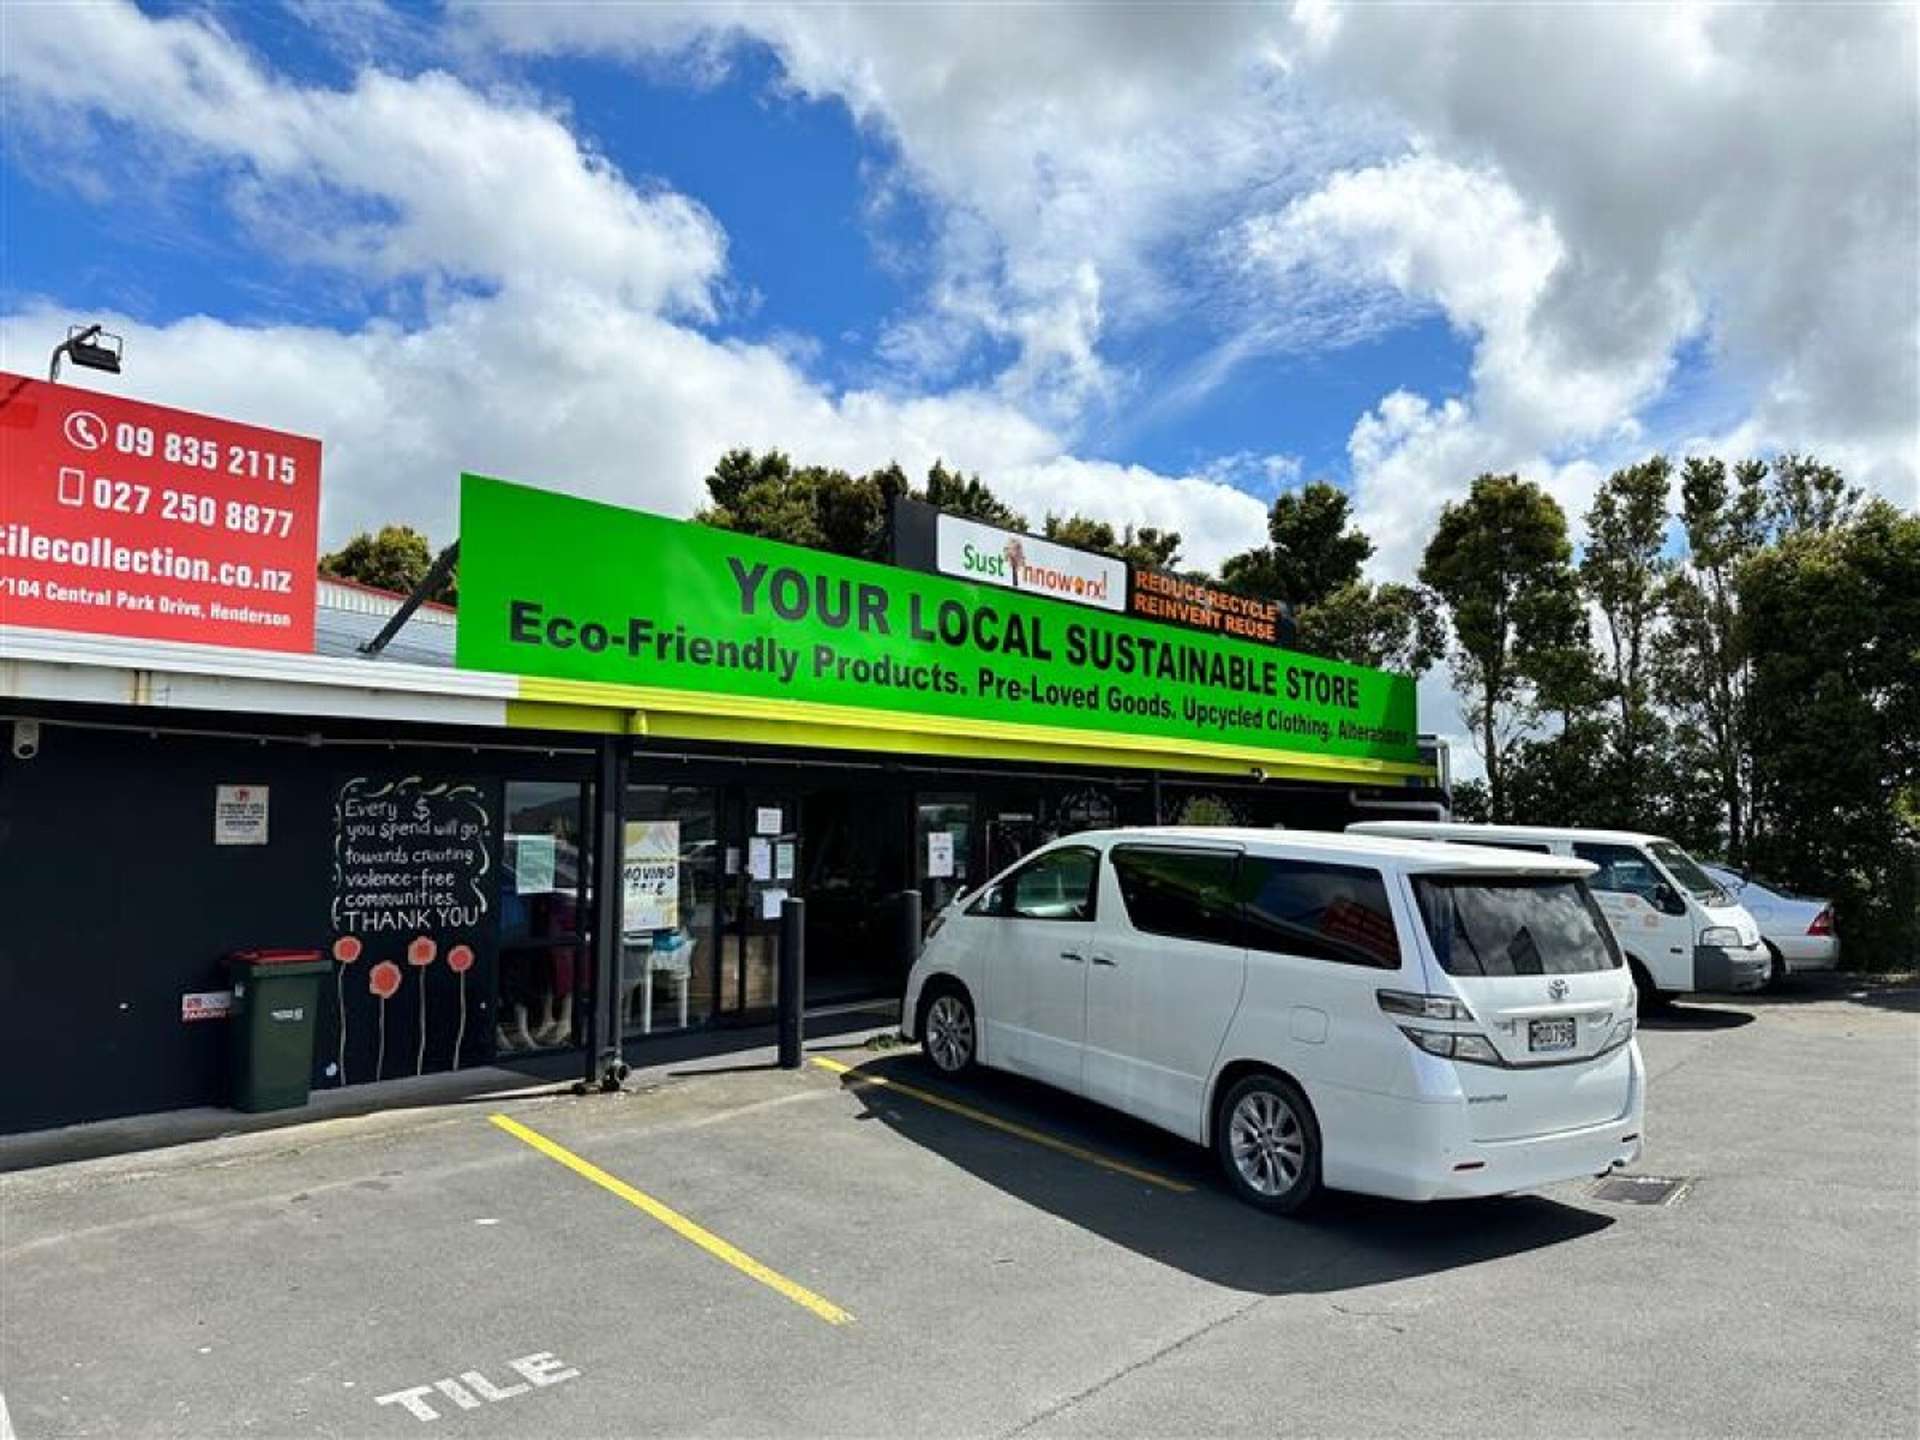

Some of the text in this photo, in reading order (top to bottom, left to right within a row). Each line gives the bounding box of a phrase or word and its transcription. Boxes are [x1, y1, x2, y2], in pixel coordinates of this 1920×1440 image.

[115, 421, 297, 485] 09 835 2115
[93, 478, 294, 539] 027 250 8877
[46, 581, 111, 607] Central
[117, 590, 154, 612] Park
[210, 602, 291, 627] Henderson
[1134, 592, 1277, 643] REINVENT REUSE
[1135, 570, 1277, 622] REDUCE RECYCLE
[727, 555, 1360, 709] YOUR LOCAL SUSTAINABLE STORE
[509, 599, 799, 684] Eco-Friendly
[813, 645, 967, 695] Products.
[978, 669, 1099, 711] Pre-Loved
[1107, 684, 1177, 719] Goods.
[1182, 695, 1262, 731] Upcycled
[345, 799, 398, 822] Every
[345, 820, 479, 842] you spend will go
[345, 845, 409, 865] towards
[345, 868, 455, 892] violence-free
[342, 905, 478, 931] THANK YOU
[374, 1350, 582, 1422] TILE
